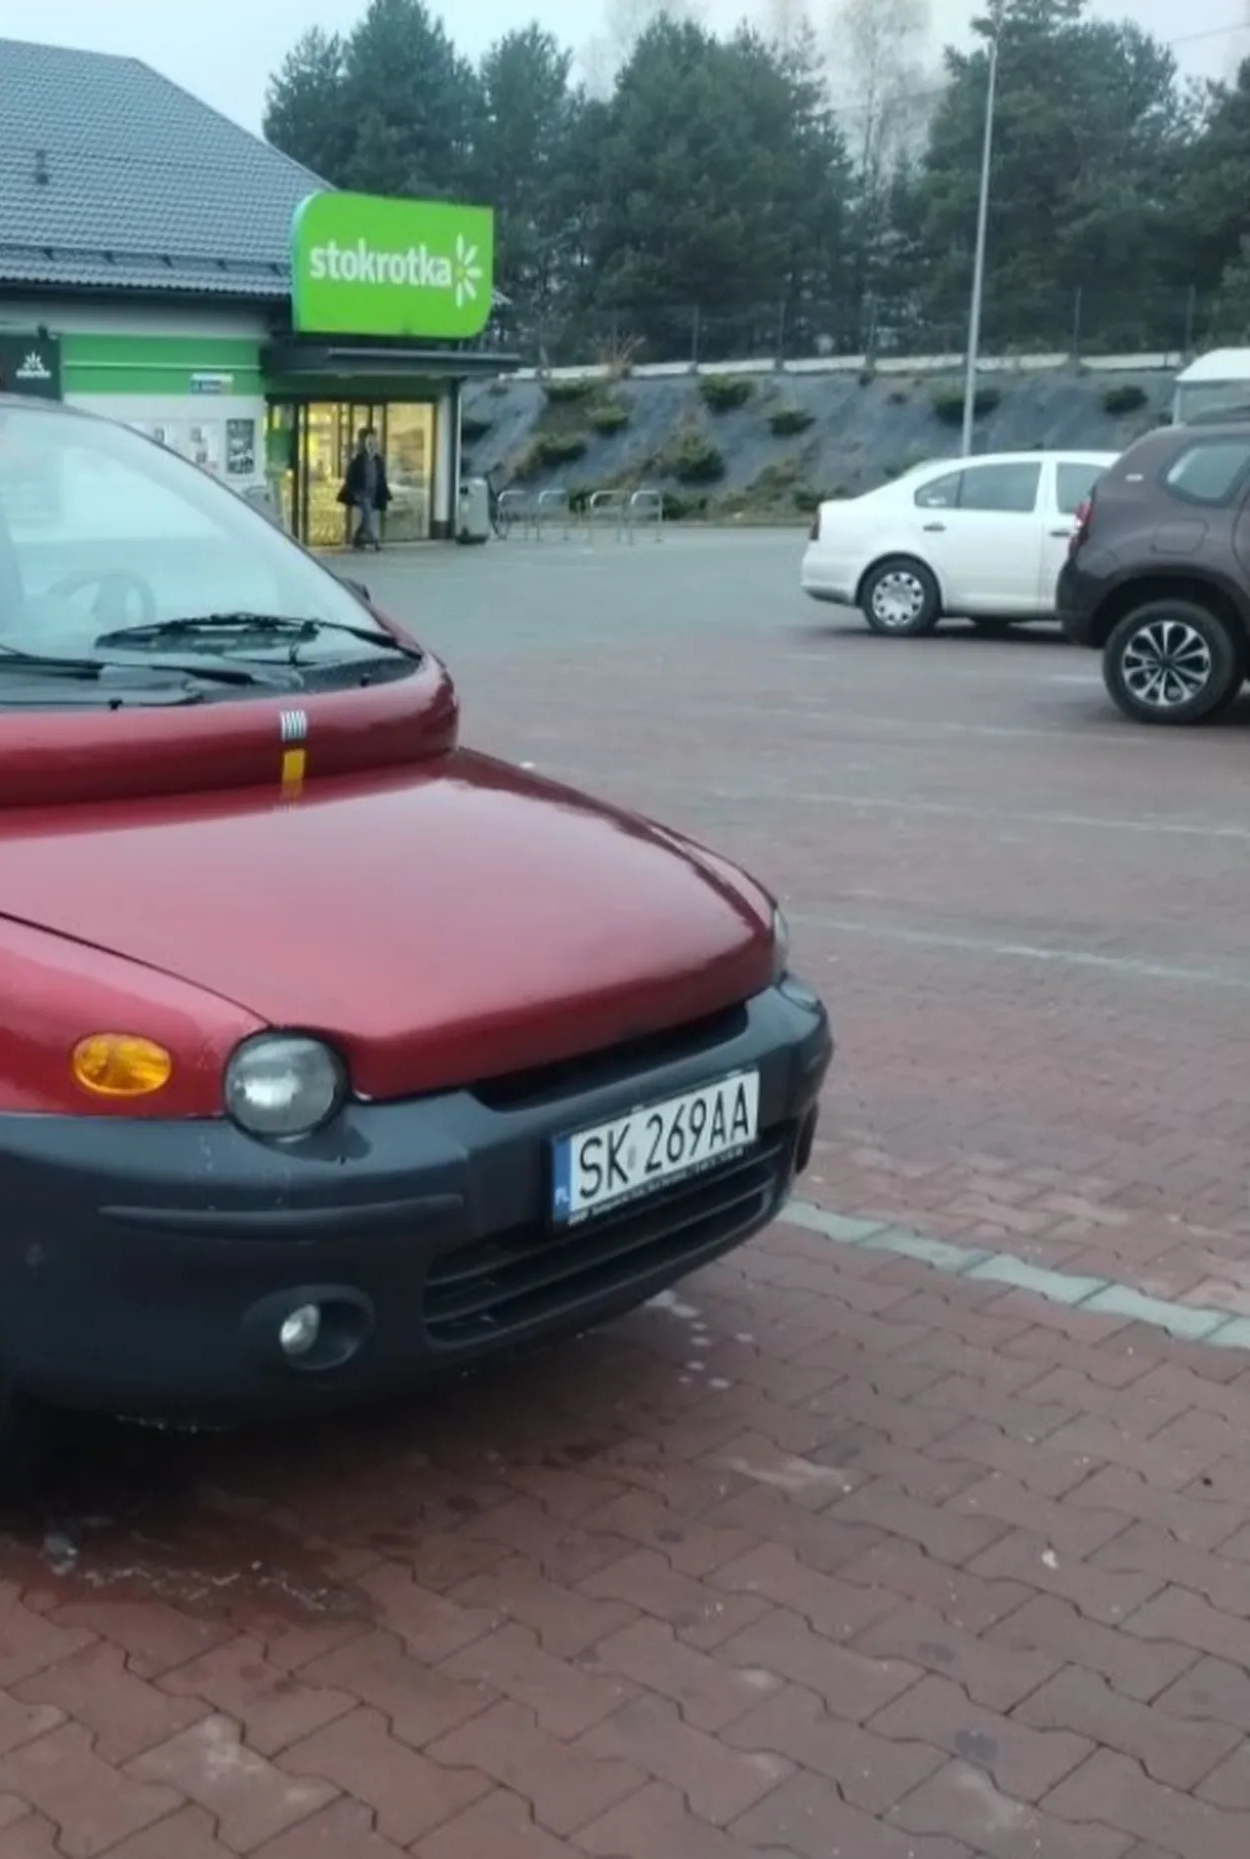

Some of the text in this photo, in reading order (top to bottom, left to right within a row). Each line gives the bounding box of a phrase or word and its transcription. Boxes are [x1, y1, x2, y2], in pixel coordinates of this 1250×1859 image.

[309, 237, 451, 286] stokrotka
[579, 1122, 631, 1199] SK
[644, 1082, 750, 1174] 269AA
